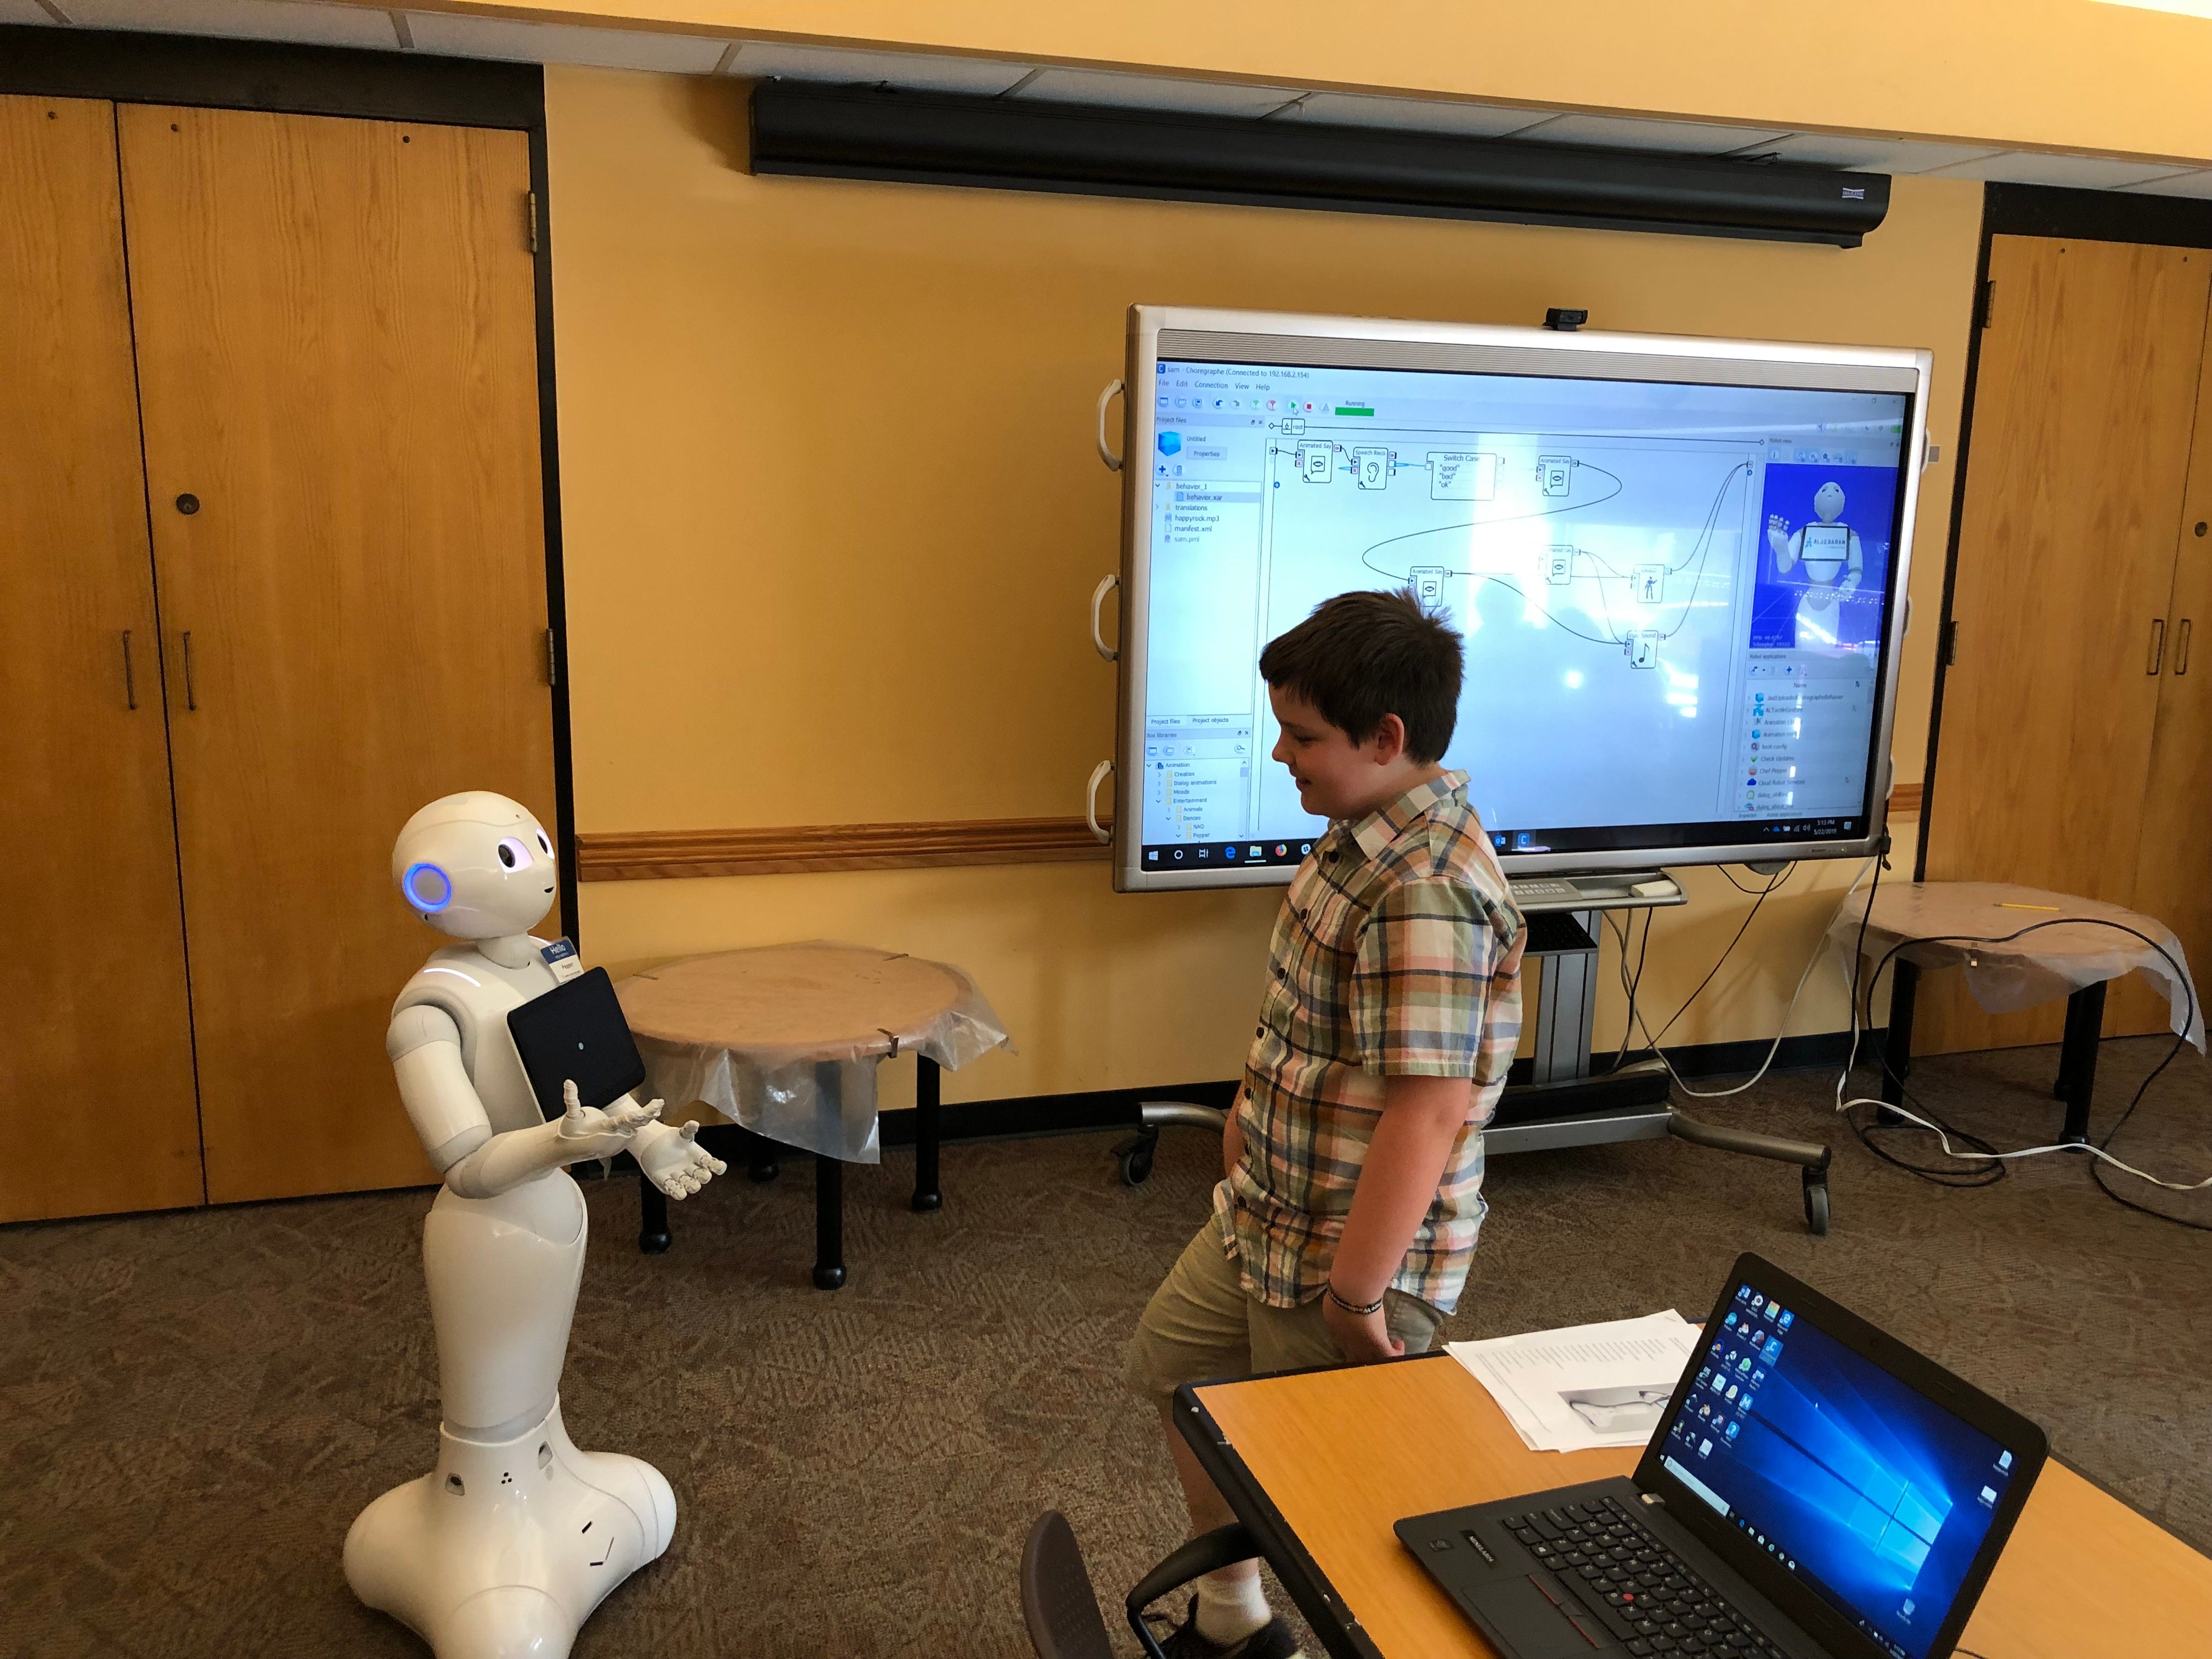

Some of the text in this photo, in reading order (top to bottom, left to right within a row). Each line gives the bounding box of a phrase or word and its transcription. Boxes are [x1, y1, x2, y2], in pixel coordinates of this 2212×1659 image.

[1186, 366, 1224, 375] Choregraphe
[1226, 368, 1259, 376] (Connected
[1269, 370, 1310, 379] 192.168.2.154)
[1194, 381, 1228, 389] Connection
[1175, 515, 1220, 523] happyrock.mp3
[550, 944, 566, 955] Hello
